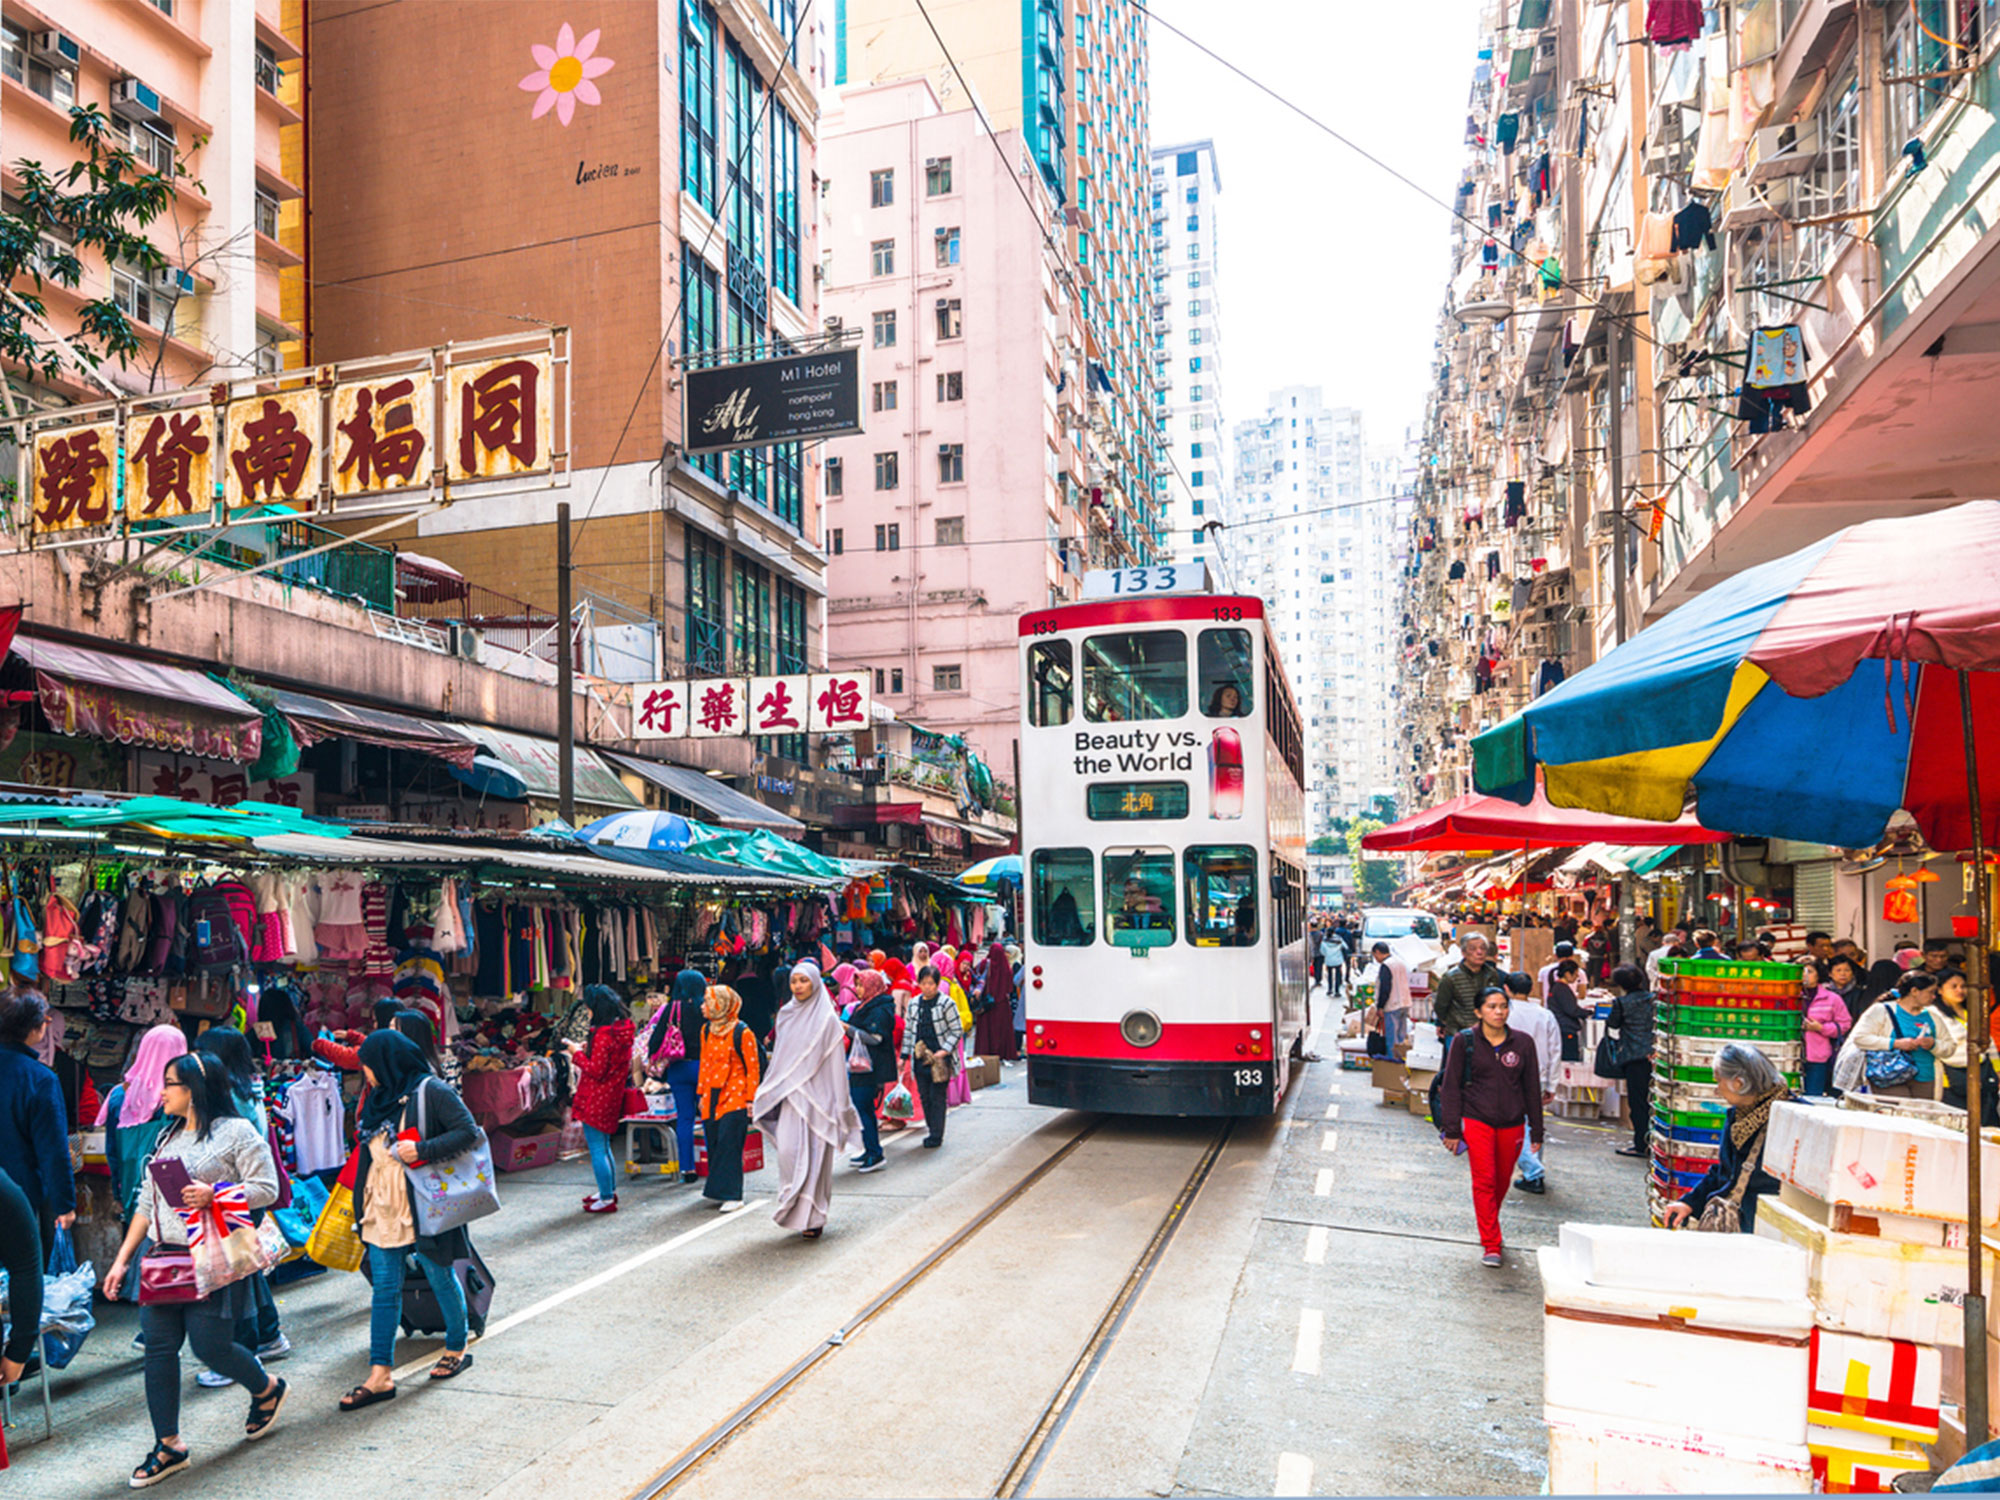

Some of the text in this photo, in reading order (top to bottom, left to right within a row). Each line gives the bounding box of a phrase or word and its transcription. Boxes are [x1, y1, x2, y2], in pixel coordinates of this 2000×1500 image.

[576, 160, 619, 185] Lucien
[781, 361, 841, 383] M1 Hotel
[788, 391, 832, 406] northpoint
[788, 407, 835, 421] hong kong
[1111, 566, 1177, 594] 133
[1212, 607, 1243, 622] 133
[1032, 620, 1058, 636] 133
[1075, 729, 1202, 752] Beauty vs.
[1073, 752, 1193, 774] the World
[1121, 792, 1154, 813] 北角
[1233, 1069, 1262, 1086] 133
